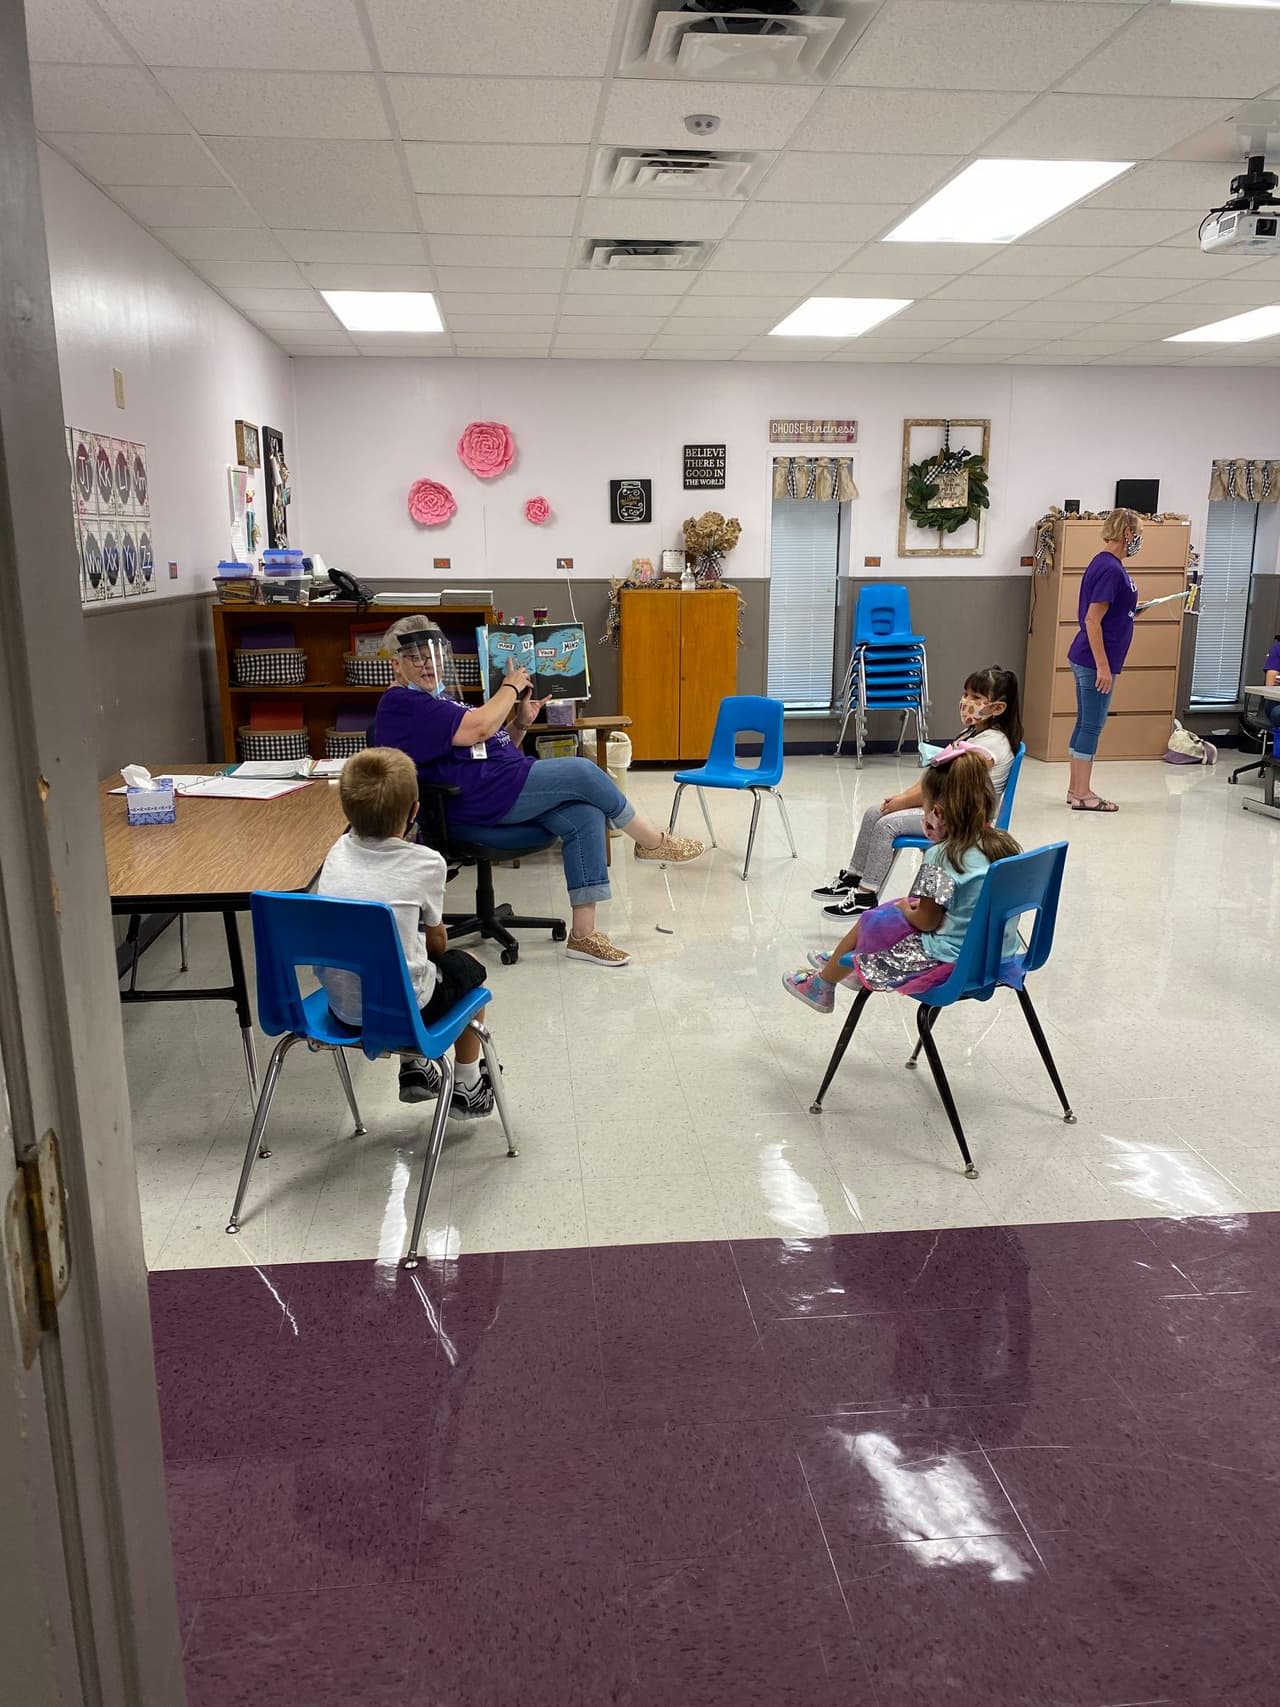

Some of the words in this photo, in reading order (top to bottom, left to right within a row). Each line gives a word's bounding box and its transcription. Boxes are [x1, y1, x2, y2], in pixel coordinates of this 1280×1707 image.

[772, 422, 805, 434] CHOOSE
[805, 422, 856, 434] kindness
[685, 448, 725, 457] BELIEVE
[685, 459, 715, 468] THERE
[716, 459, 725, 468] IS
[686, 469, 712, 478] GOOD
[714, 469, 724, 478] IN
[685, 478, 699, 486] THE
[700, 478, 725, 486] WORLD
[523, 641, 533, 649] UP
